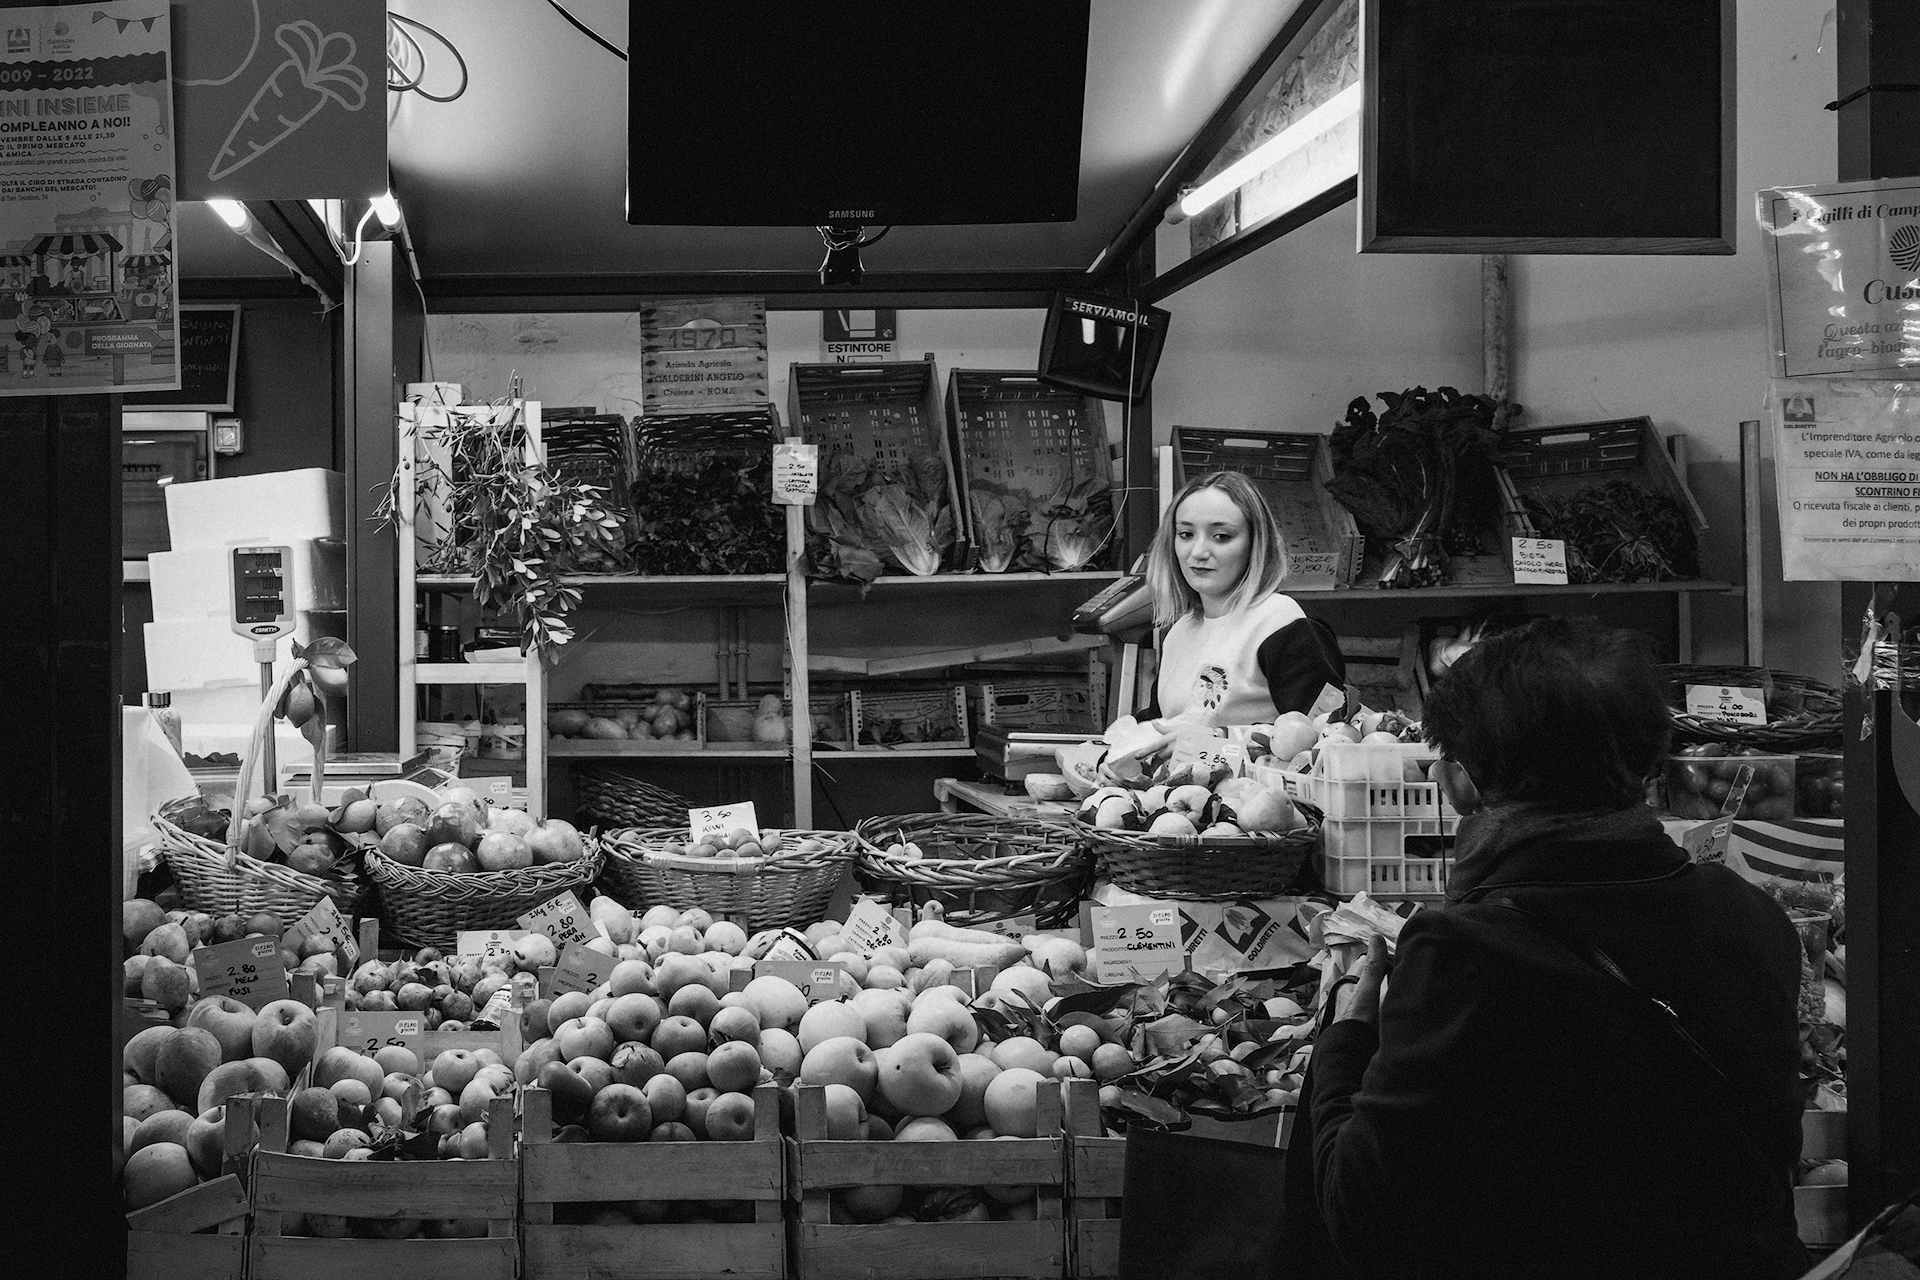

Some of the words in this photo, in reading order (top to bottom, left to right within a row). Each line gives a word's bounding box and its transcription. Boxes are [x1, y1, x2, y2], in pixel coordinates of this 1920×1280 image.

[53, 66, 94, 81] 2022
[37, 93, 130, 116] INSIEME
[91, 119, 100, 129] A
[103, 116, 131, 128] NOI!
[28, 179, 46, 187] CIBO
[48, 179, 56, 187] DI
[57, 177, 85, 186] STRADA
[86, 175, 128, 185] CONTADINO
[45, 185, 59, 193] DEL
[60, 184, 97, 193] MERCATO!
[829, 209, 875, 219] SAMSUNG
[1857, 205, 1872, 220] di
[1071, 301, 1137, 323] SERVIAMO
[1138, 314, 1149, 327] IL
[92, 333, 140, 343] PROGRAMMA
[1822, 322, 1881, 343] Questa
[669, 328, 736, 350] 1970
[92, 341, 116, 350] DELLA
[116, 340, 153, 349] GIORNATA
[828, 342, 892, 353] ESTINTORE
[698, 359, 732, 371] Agricola
[655, 373, 705, 383] CALDERINI
[706, 372, 746, 382] ANGELO
[1801, 431, 1872, 443] L'Imprenditore
[1804, 448, 1843, 459] speciale
[1865, 450, 1892, 459] come
[1894, 448, 1905, 459] da
[1815, 471, 1838, 480] NON
[1841, 471, 1854, 481] HA
[1856, 471, 1906, 481] L'OBBLIGO
[1909, 472, 1919, 481] DI
[1855, 486, 1911, 497] SCONTRINO
[1803, 500, 1841, 511] ricevuta
[1843, 500, 1871, 511] fiscale
[1873, 502, 1882, 511] ai
[1883, 501, 1914, 514] clienti,
[1843, 517, 1857, 528] dei
[1858, 518, 1886, 531] propri
[1290, 554, 1331, 564] VERZE
[254, 626, 279, 634] ZENITH
[702, 823, 725, 833] KIWI
[558, 926, 578, 941] PERA
[1127, 940, 1176, 951] CLEMENTINI
[1247, 920, 1281, 962] COLDIRETTI
[235, 974, 260, 985] MELA
[229, 986, 251, 996] FUJI
